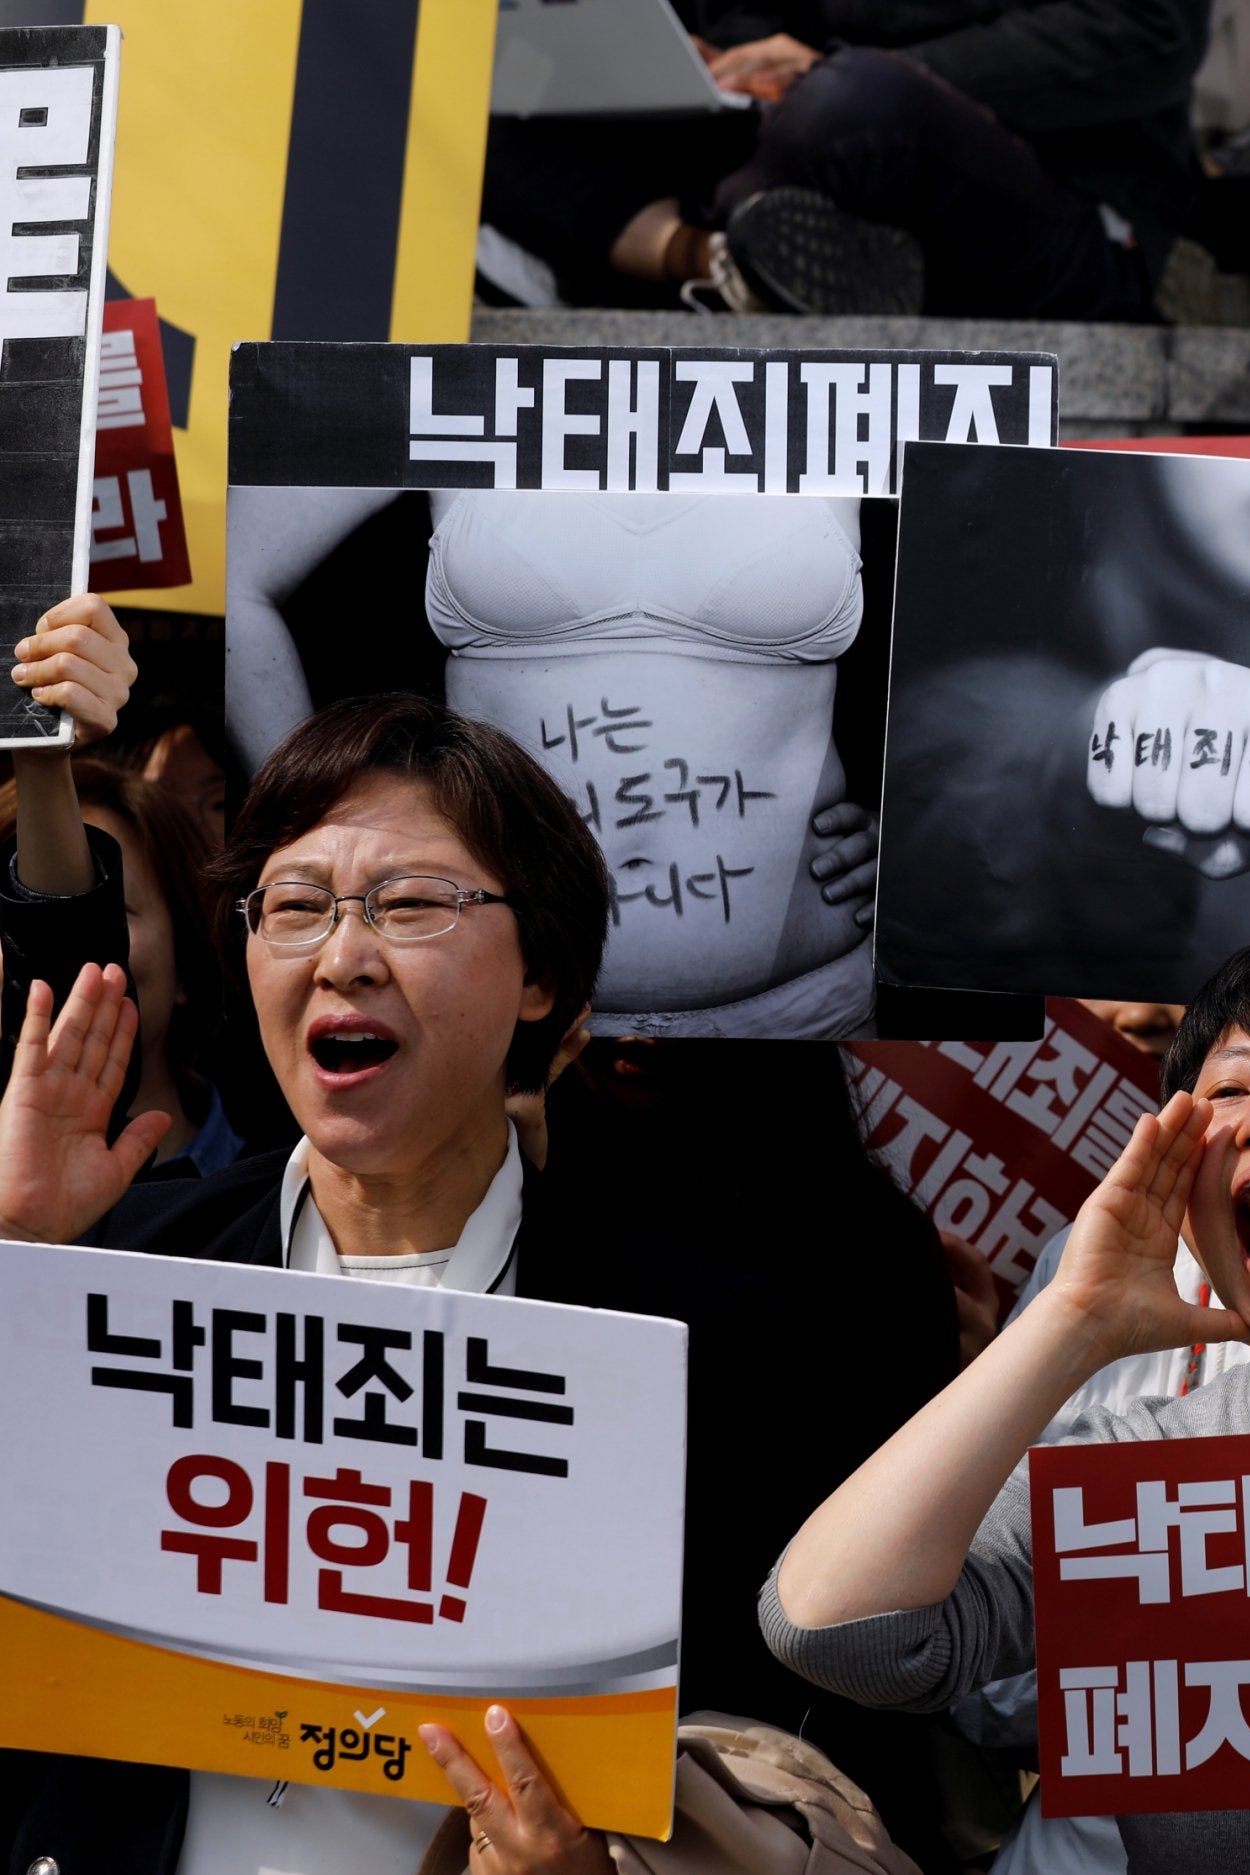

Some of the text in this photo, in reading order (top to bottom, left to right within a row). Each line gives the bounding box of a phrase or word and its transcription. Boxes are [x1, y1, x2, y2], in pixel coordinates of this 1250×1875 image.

[539, 696, 653, 763] 나는
[615, 757, 778, 830] 도구가
[87, 1292, 575, 1478] 낙태죄는
[161, 1454, 488, 1625] 위헌!
[300, 1723, 412, 1782] 정의당
